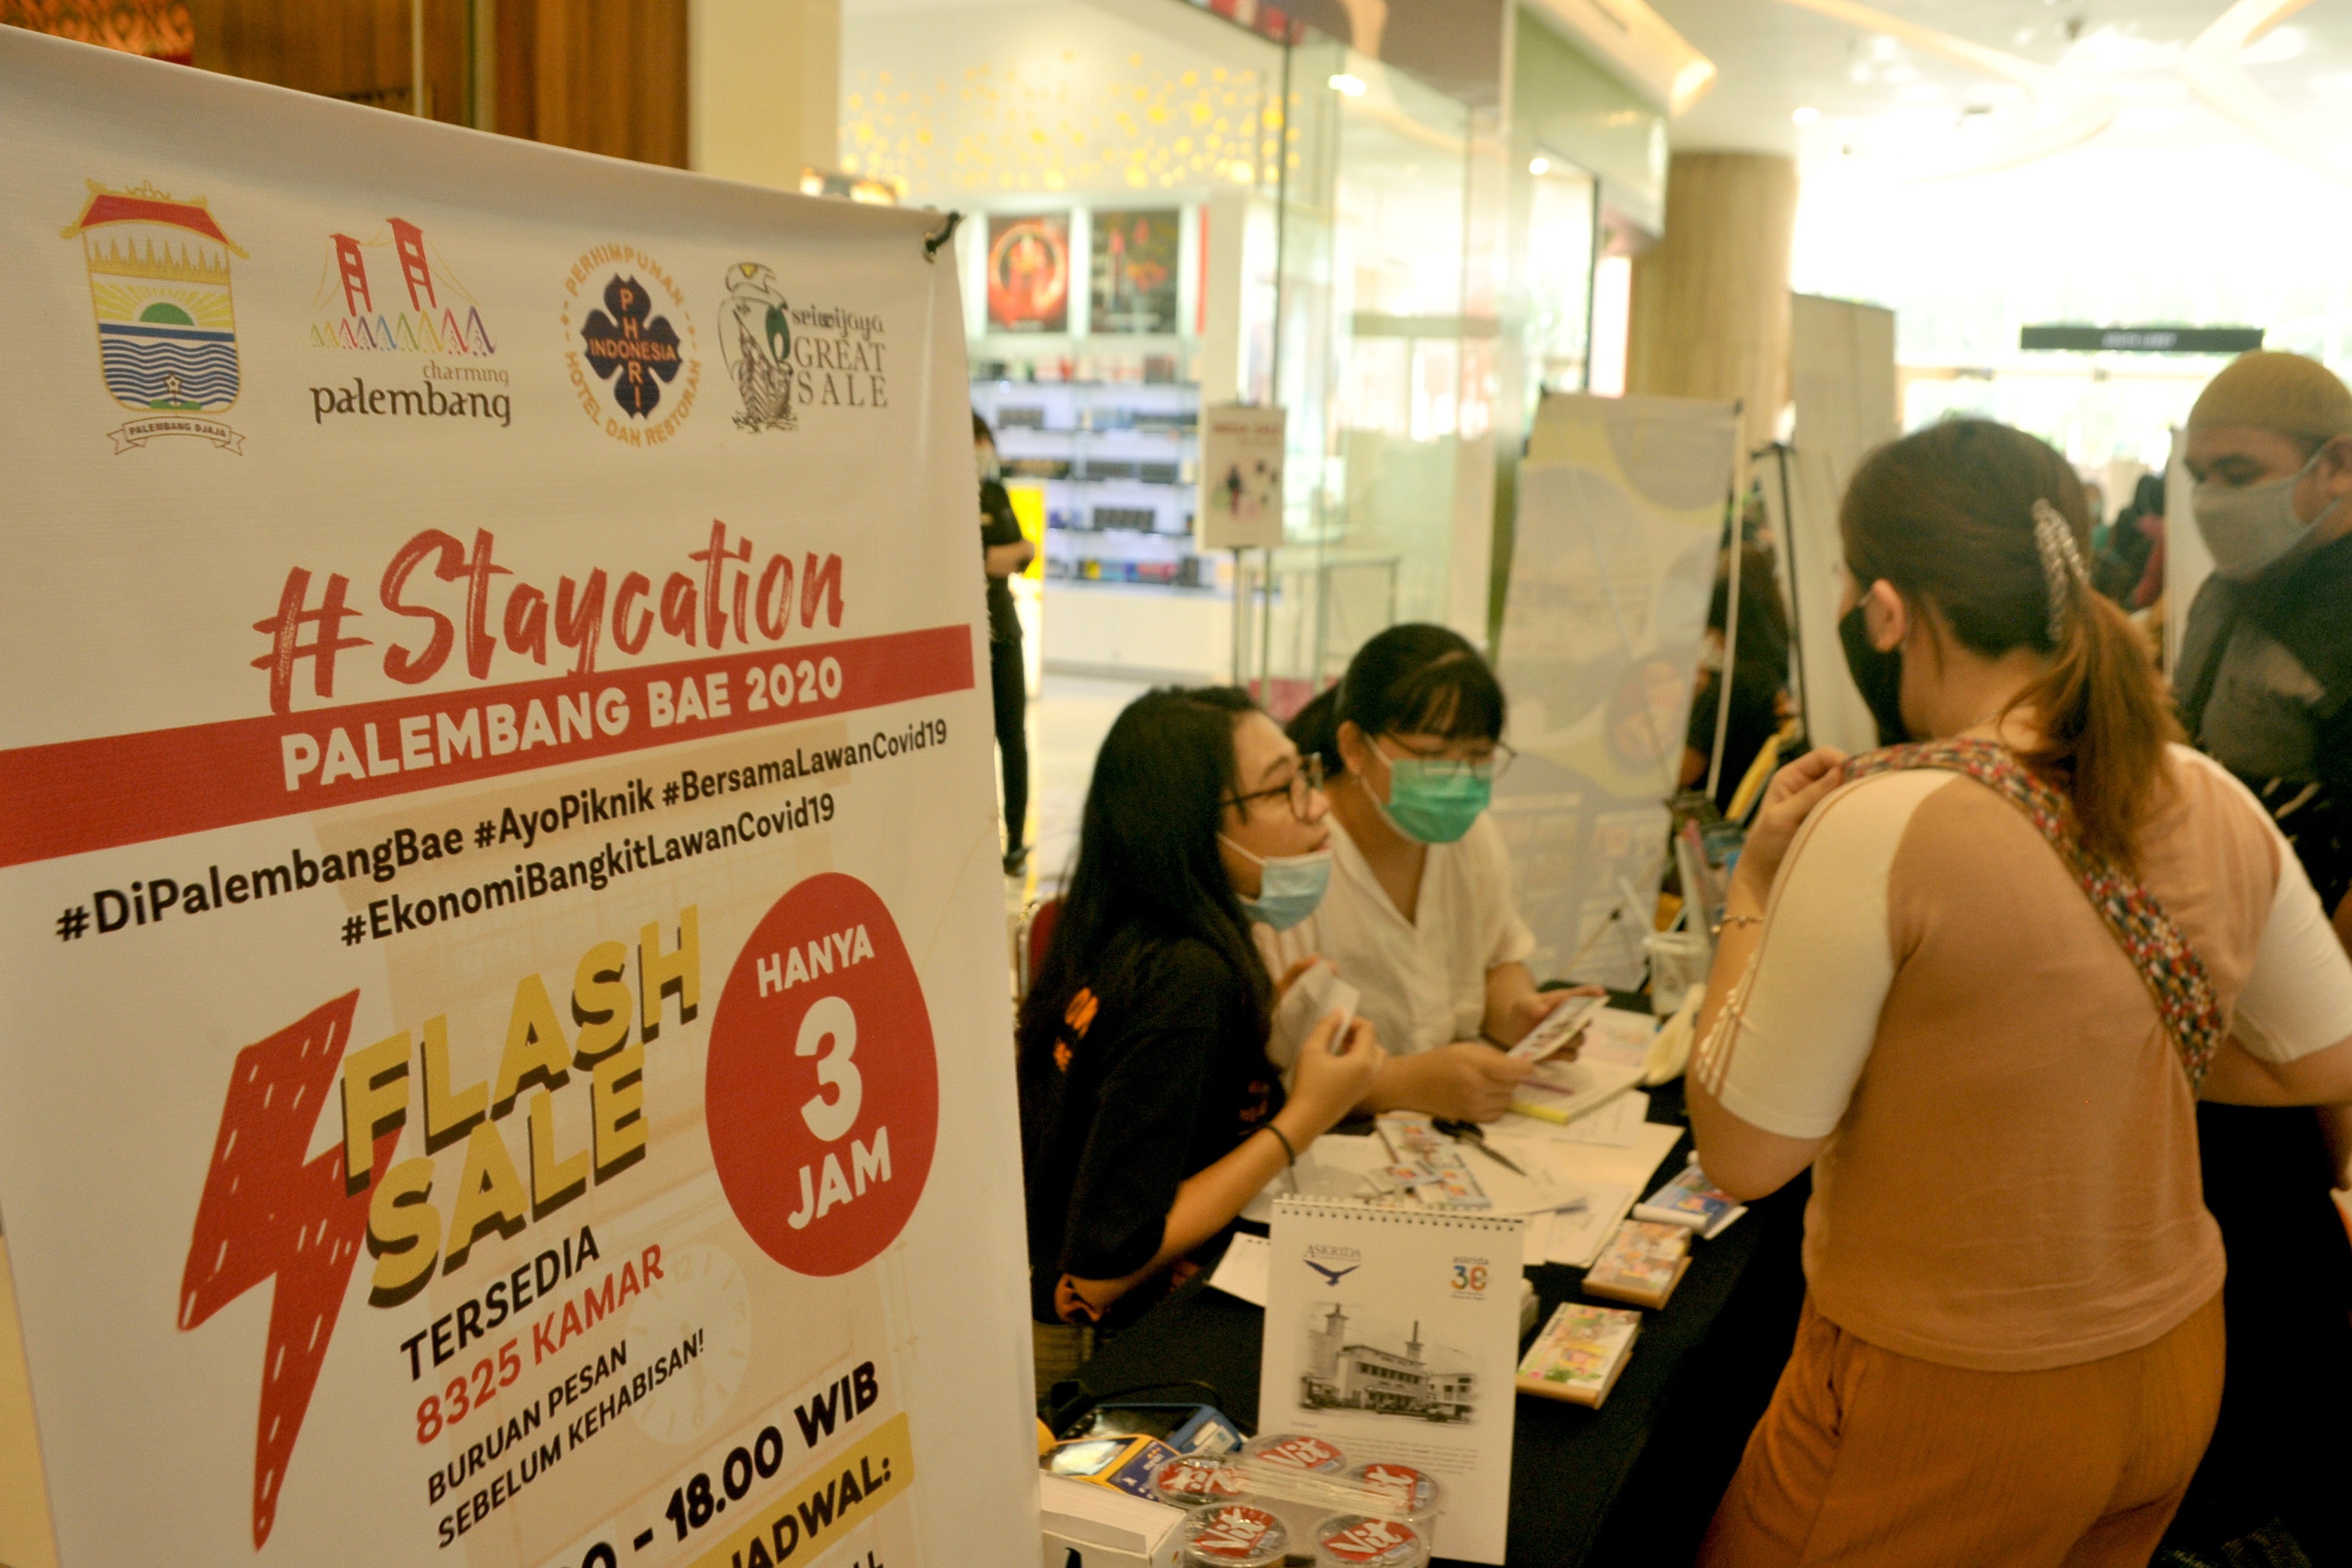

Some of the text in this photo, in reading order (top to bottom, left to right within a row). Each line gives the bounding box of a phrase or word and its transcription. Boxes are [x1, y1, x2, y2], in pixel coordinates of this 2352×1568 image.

[564, 242, 684, 307] PERHIMPUNAN
[791, 303, 884, 341] sriwijaya
[309, 376, 511, 427] palembang
[422, 359, 509, 388] charming
[564, 350, 701, 449] HOTEL DAN RESTORAN
[589, 338, 677, 361] INDONESIA
[793, 335, 886, 373] GREAT
[797, 370, 888, 407] SALE
[129, 422, 226, 437] PALEMBANG DJAJA
[251, 518, 844, 714] #Staycation
[281, 656, 843, 792] PALEMBANG BAE 2020
[55, 718, 948, 942] #DiPalembangBae #AyoPiknik #BersamaLawanCovid19
[341, 792, 835, 946] #EkonomiBangkitLawanCovid19
[756, 924, 875, 997] HANYA
[340, 904, 701, 1198] FLASH
[794, 996, 863, 1142] 3
[366, 1040, 648, 1309] SALE
[787, 1126, 892, 1230] JAM
[400, 1224, 601, 1383] TERSEDIA
[415, 1243, 665, 1445] 8325 KAMAR
[427, 1339, 627, 1506] BURUAN PESAN
[437, 1327, 704, 1549] SEBELUM KEHABISAN!
[664, 1425, 784, 1542] 18.00
[793, 1361, 879, 1449] WIB
